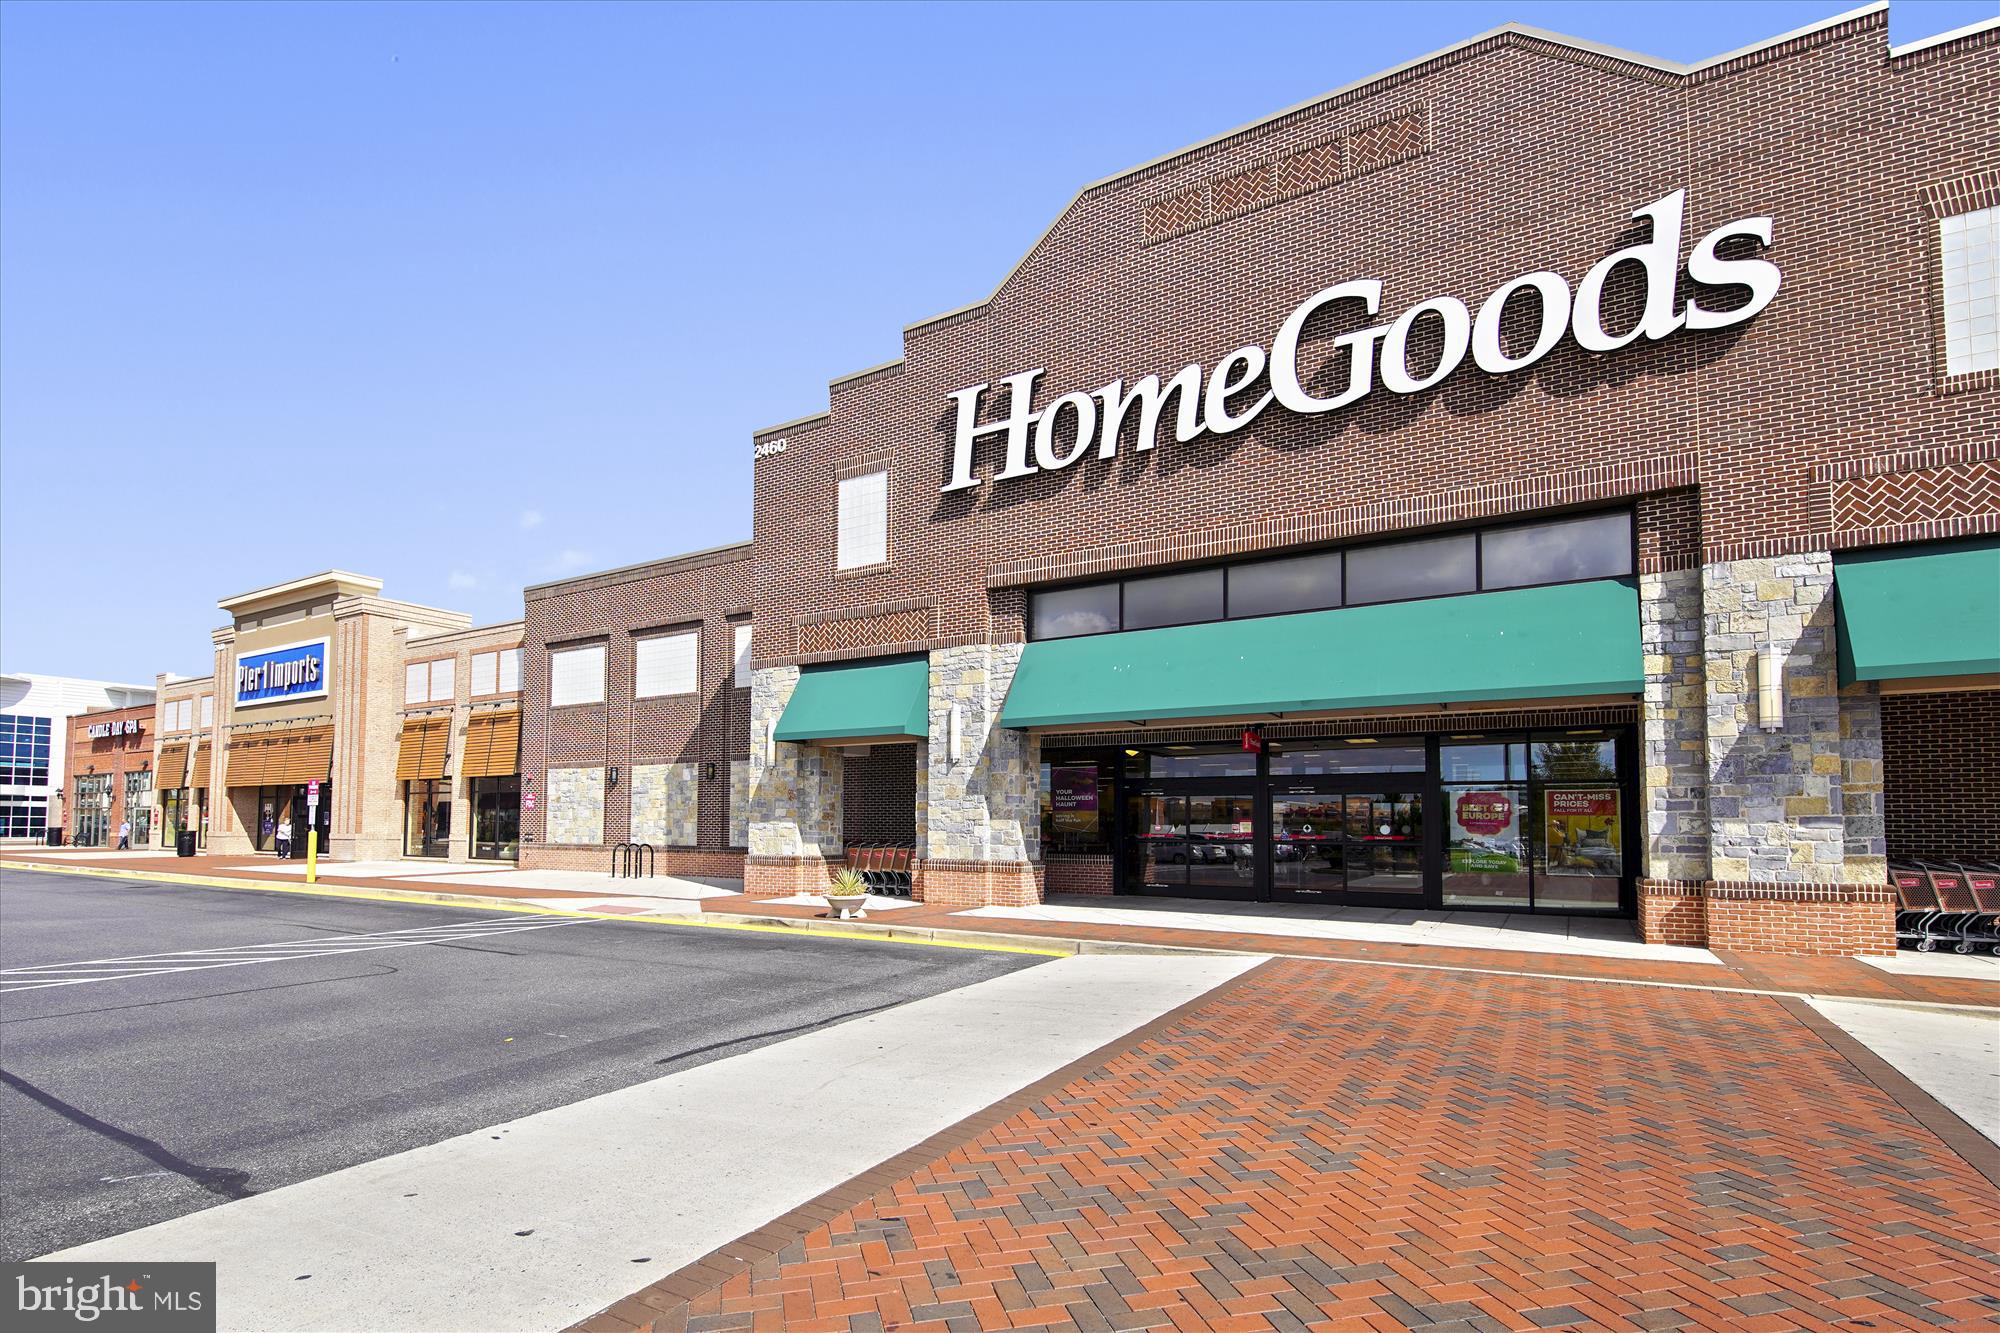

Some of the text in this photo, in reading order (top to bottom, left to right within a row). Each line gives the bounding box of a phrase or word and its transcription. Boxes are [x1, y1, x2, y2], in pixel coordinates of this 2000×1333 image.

[941, 188, 1783, 493] HomeGoods
[755, 438, 787, 459] 2460
[239, 654, 318, 692] Pier 1 imports
[88, 719, 138, 738] CANDLE DAY SPA
[1553, 793, 1612, 801] CAN'T-MISS
[1462, 812, 1505, 821] EUROPE
